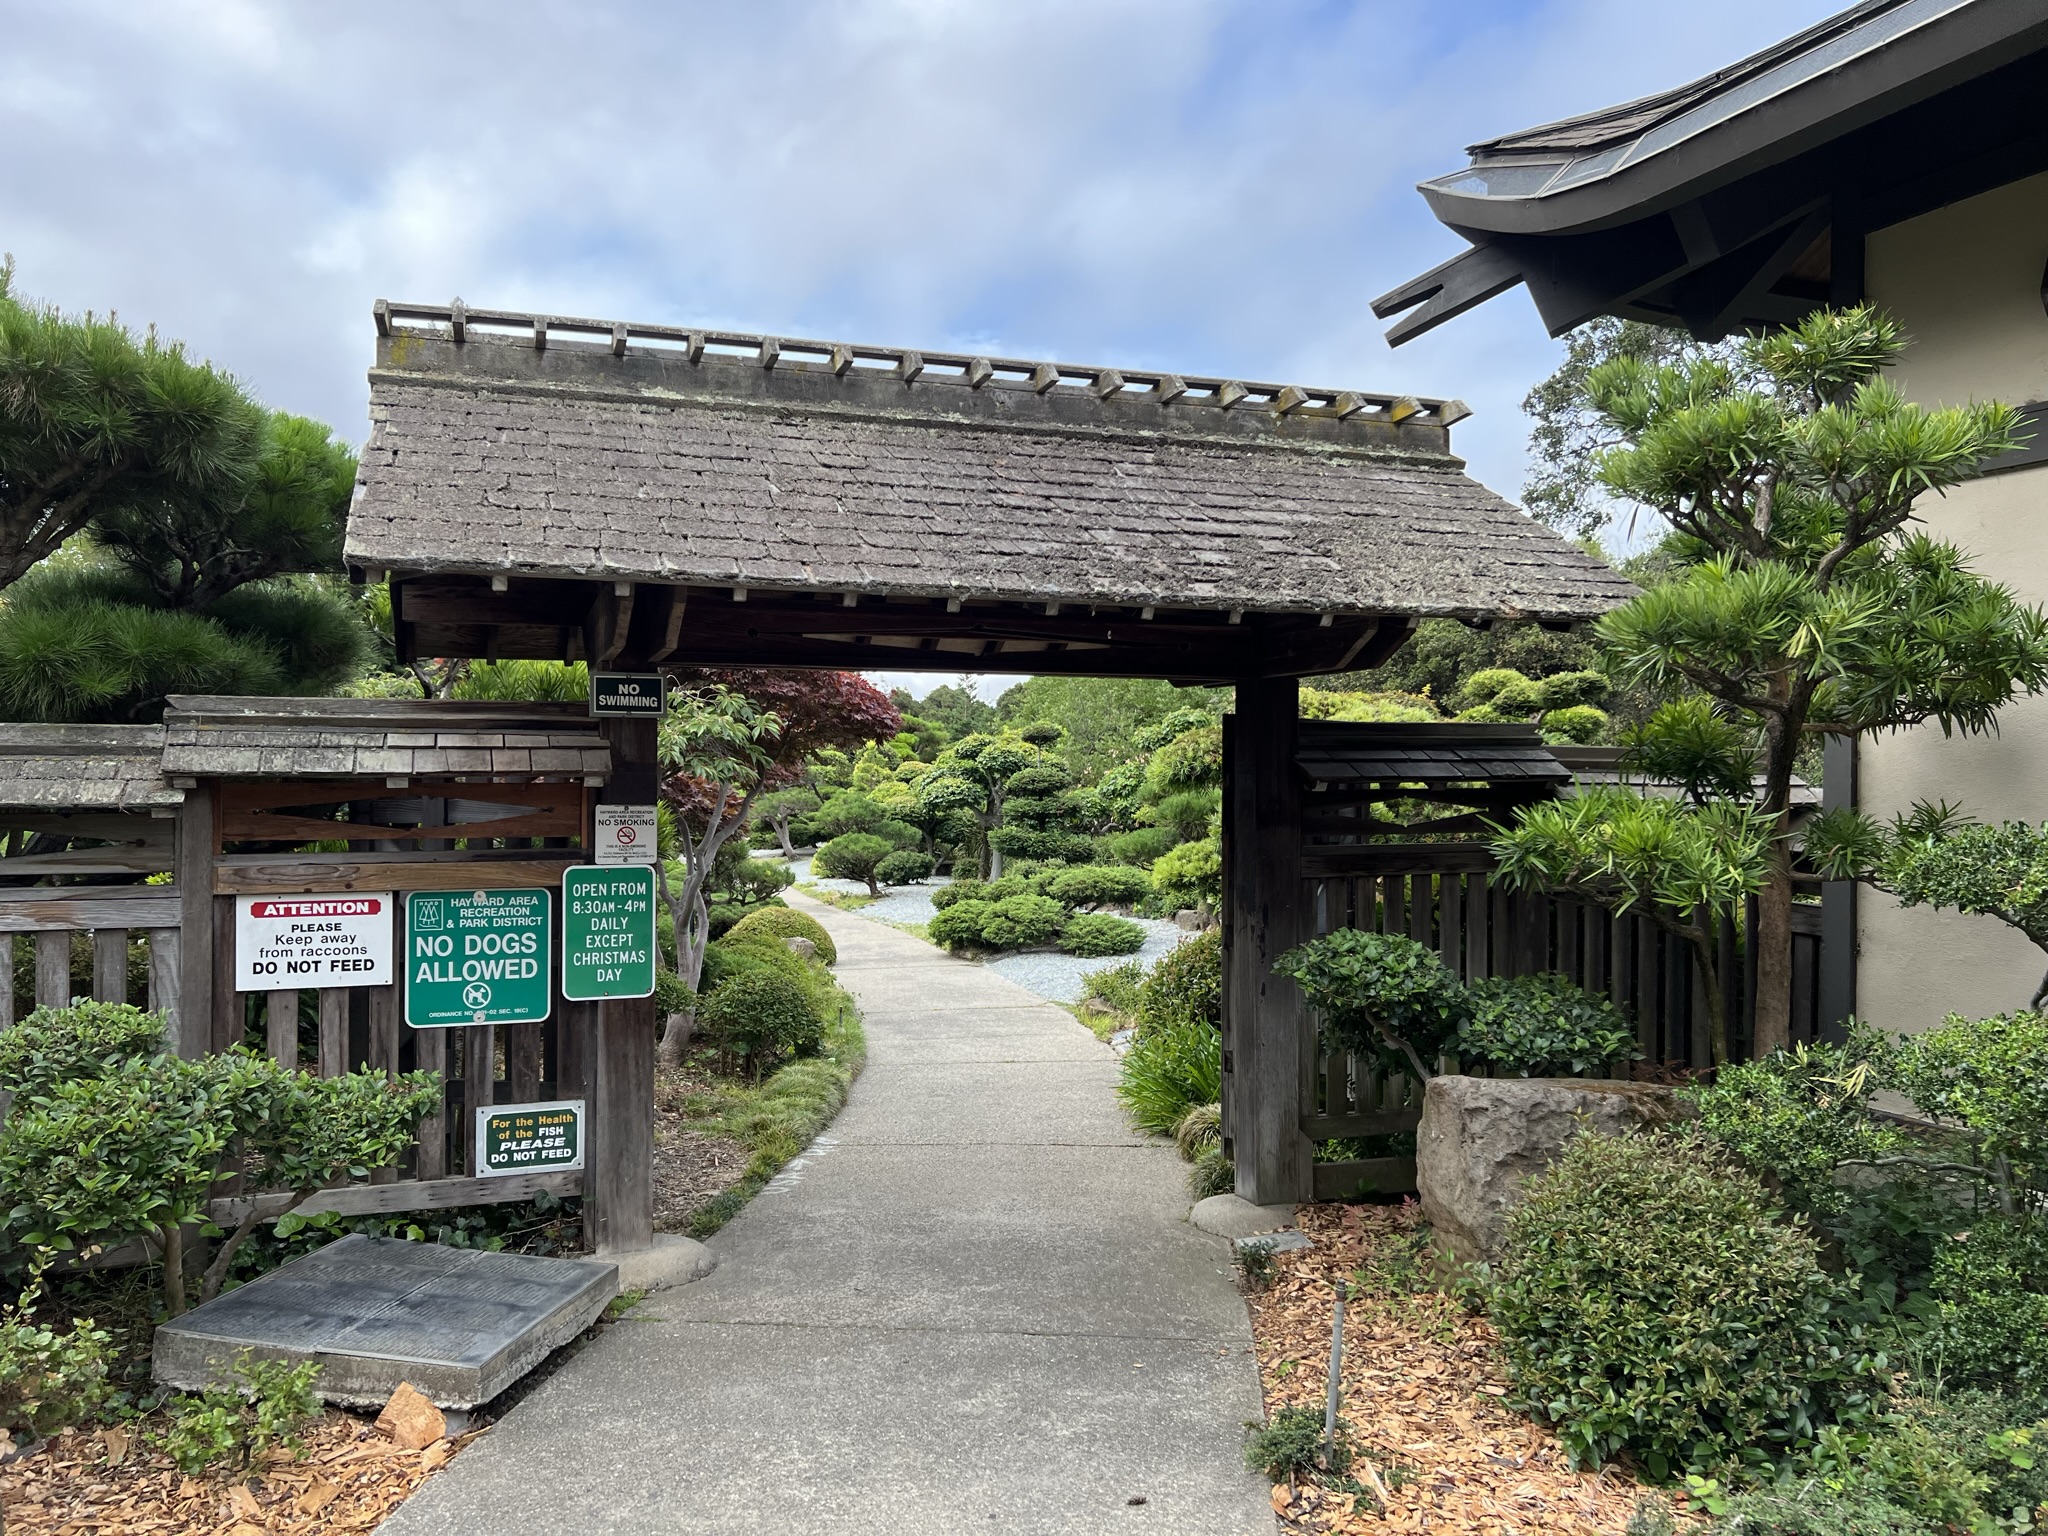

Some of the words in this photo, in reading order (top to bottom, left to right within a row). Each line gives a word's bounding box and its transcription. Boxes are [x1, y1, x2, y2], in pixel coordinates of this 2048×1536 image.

[618, 684, 640, 695] NO
[598, 694, 658, 707] SWIMMING
[573, 883, 607, 897] OPEN
[611, 883, 646, 895] FROM
[451, 897, 504, 907] HAYWARD
[508, 896, 538, 905] AREA
[263, 901, 369, 916] ATTENTION
[460, 907, 530, 917] RECREATION
[291, 922, 343, 933] PLEASE
[446, 919, 455, 928] &
[459, 919, 488, 928] PARK
[493, 916, 543, 927] DISTRICT
[591, 917, 628, 930] DAILY
[275, 934, 313, 947] Keep
[320, 934, 357, 945] away
[416, 935, 453, 957] NO
[464, 932, 537, 956] DOGS
[586, 934, 633, 948] EXCEPT
[259, 947, 293, 959] from
[300, 946, 367, 957] raccoons
[573, 950, 646, 965] CHRISTMAS
[252, 961, 278, 975] DO
[286, 960, 321, 974] NOT
[330, 958, 375, 973] FEED
[415, 958, 538, 983] ALLOWED
[597, 969, 622, 982] DAY
[492, 1119, 511, 1128] For
[515, 1117, 533, 1127] the
[538, 1114, 573, 1125] Health
[498, 1130, 510, 1139] of
[515, 1129, 533, 1139] the
[538, 1126, 564, 1137] FISH
[499, 1137, 566, 1151] PLEASE
[491, 1153, 508, 1163] DO
[513, 1151, 537, 1161] NOT
[541, 1148, 572, 1159] FEED
